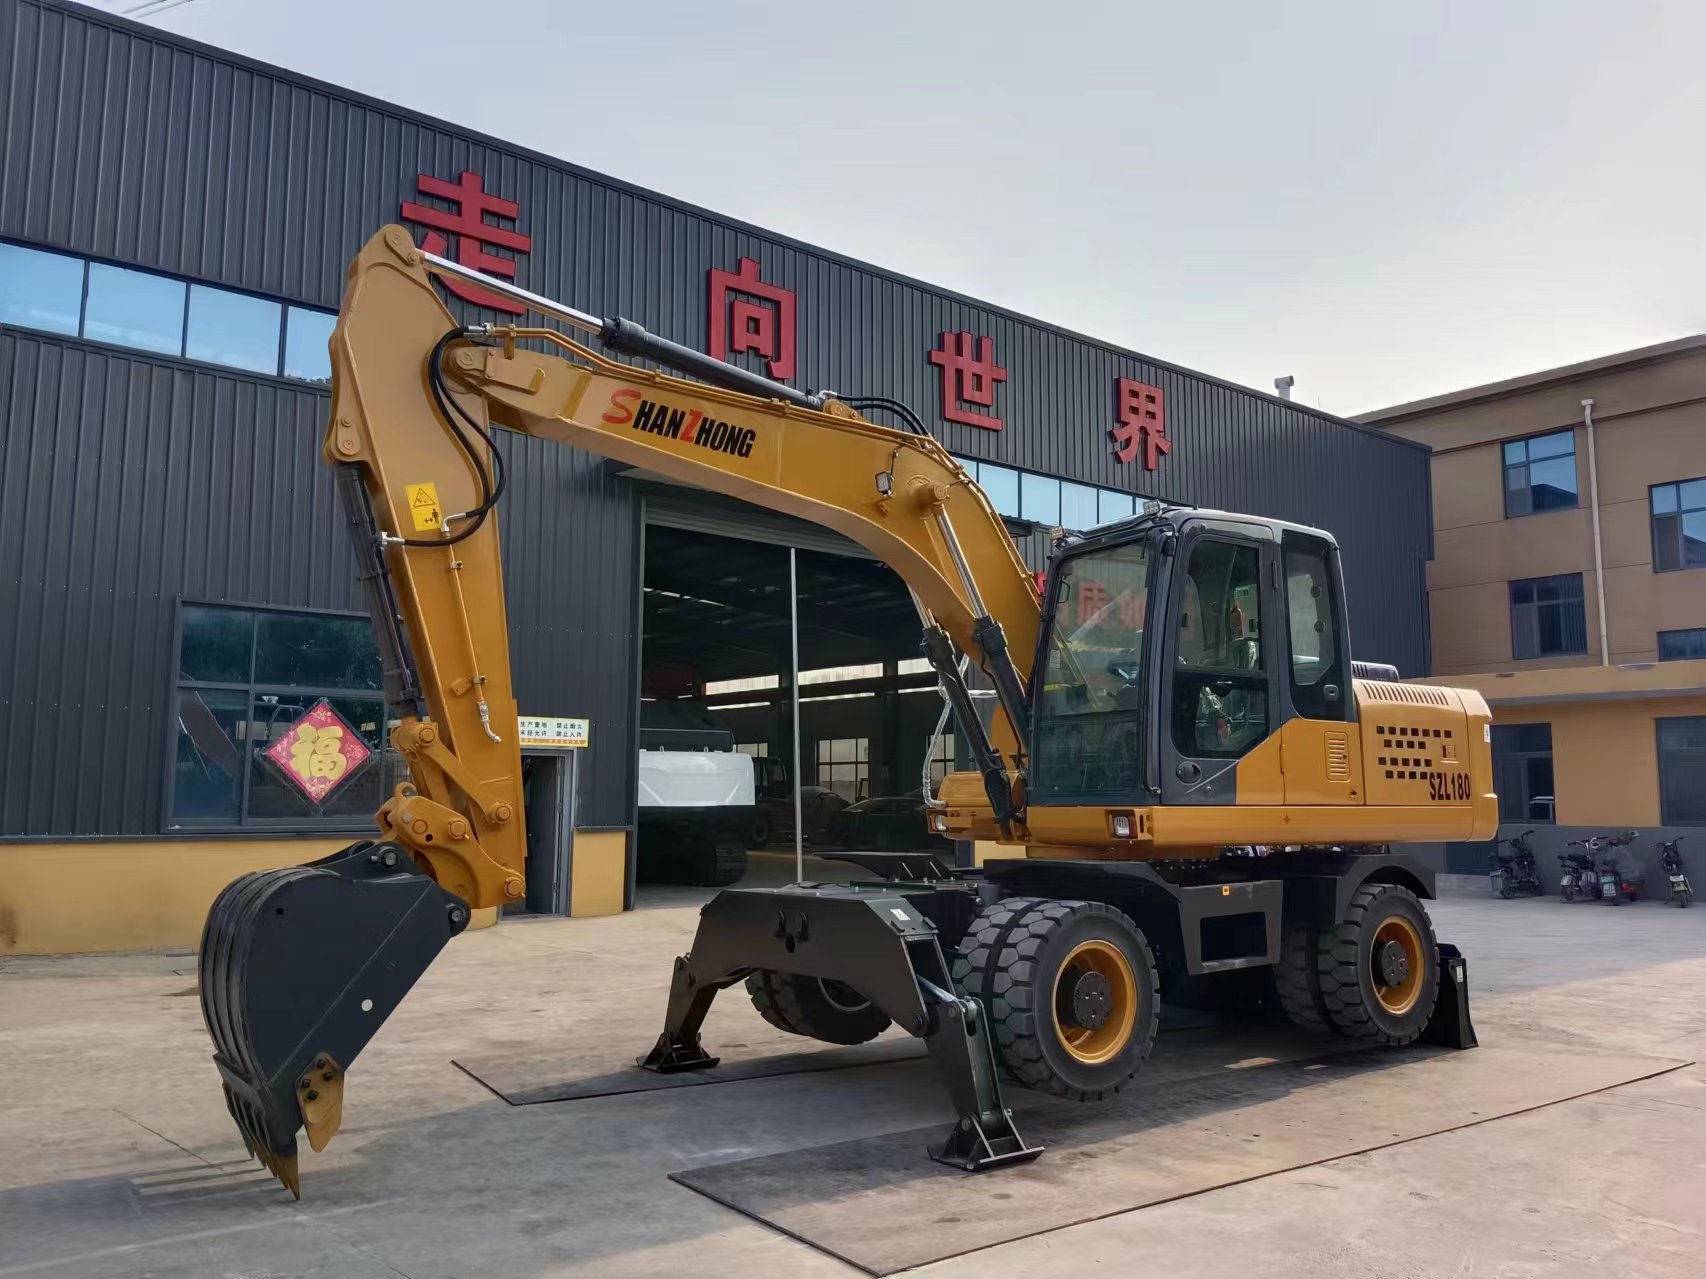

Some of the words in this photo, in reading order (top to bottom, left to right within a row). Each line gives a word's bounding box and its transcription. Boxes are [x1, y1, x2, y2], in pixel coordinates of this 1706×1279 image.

[602, 389, 757, 459] SHANZHONG
[289, 722, 348, 780] 福
[556, 730, 582, 738] 禁止入内
[1429, 771, 1471, 801] SZL180
